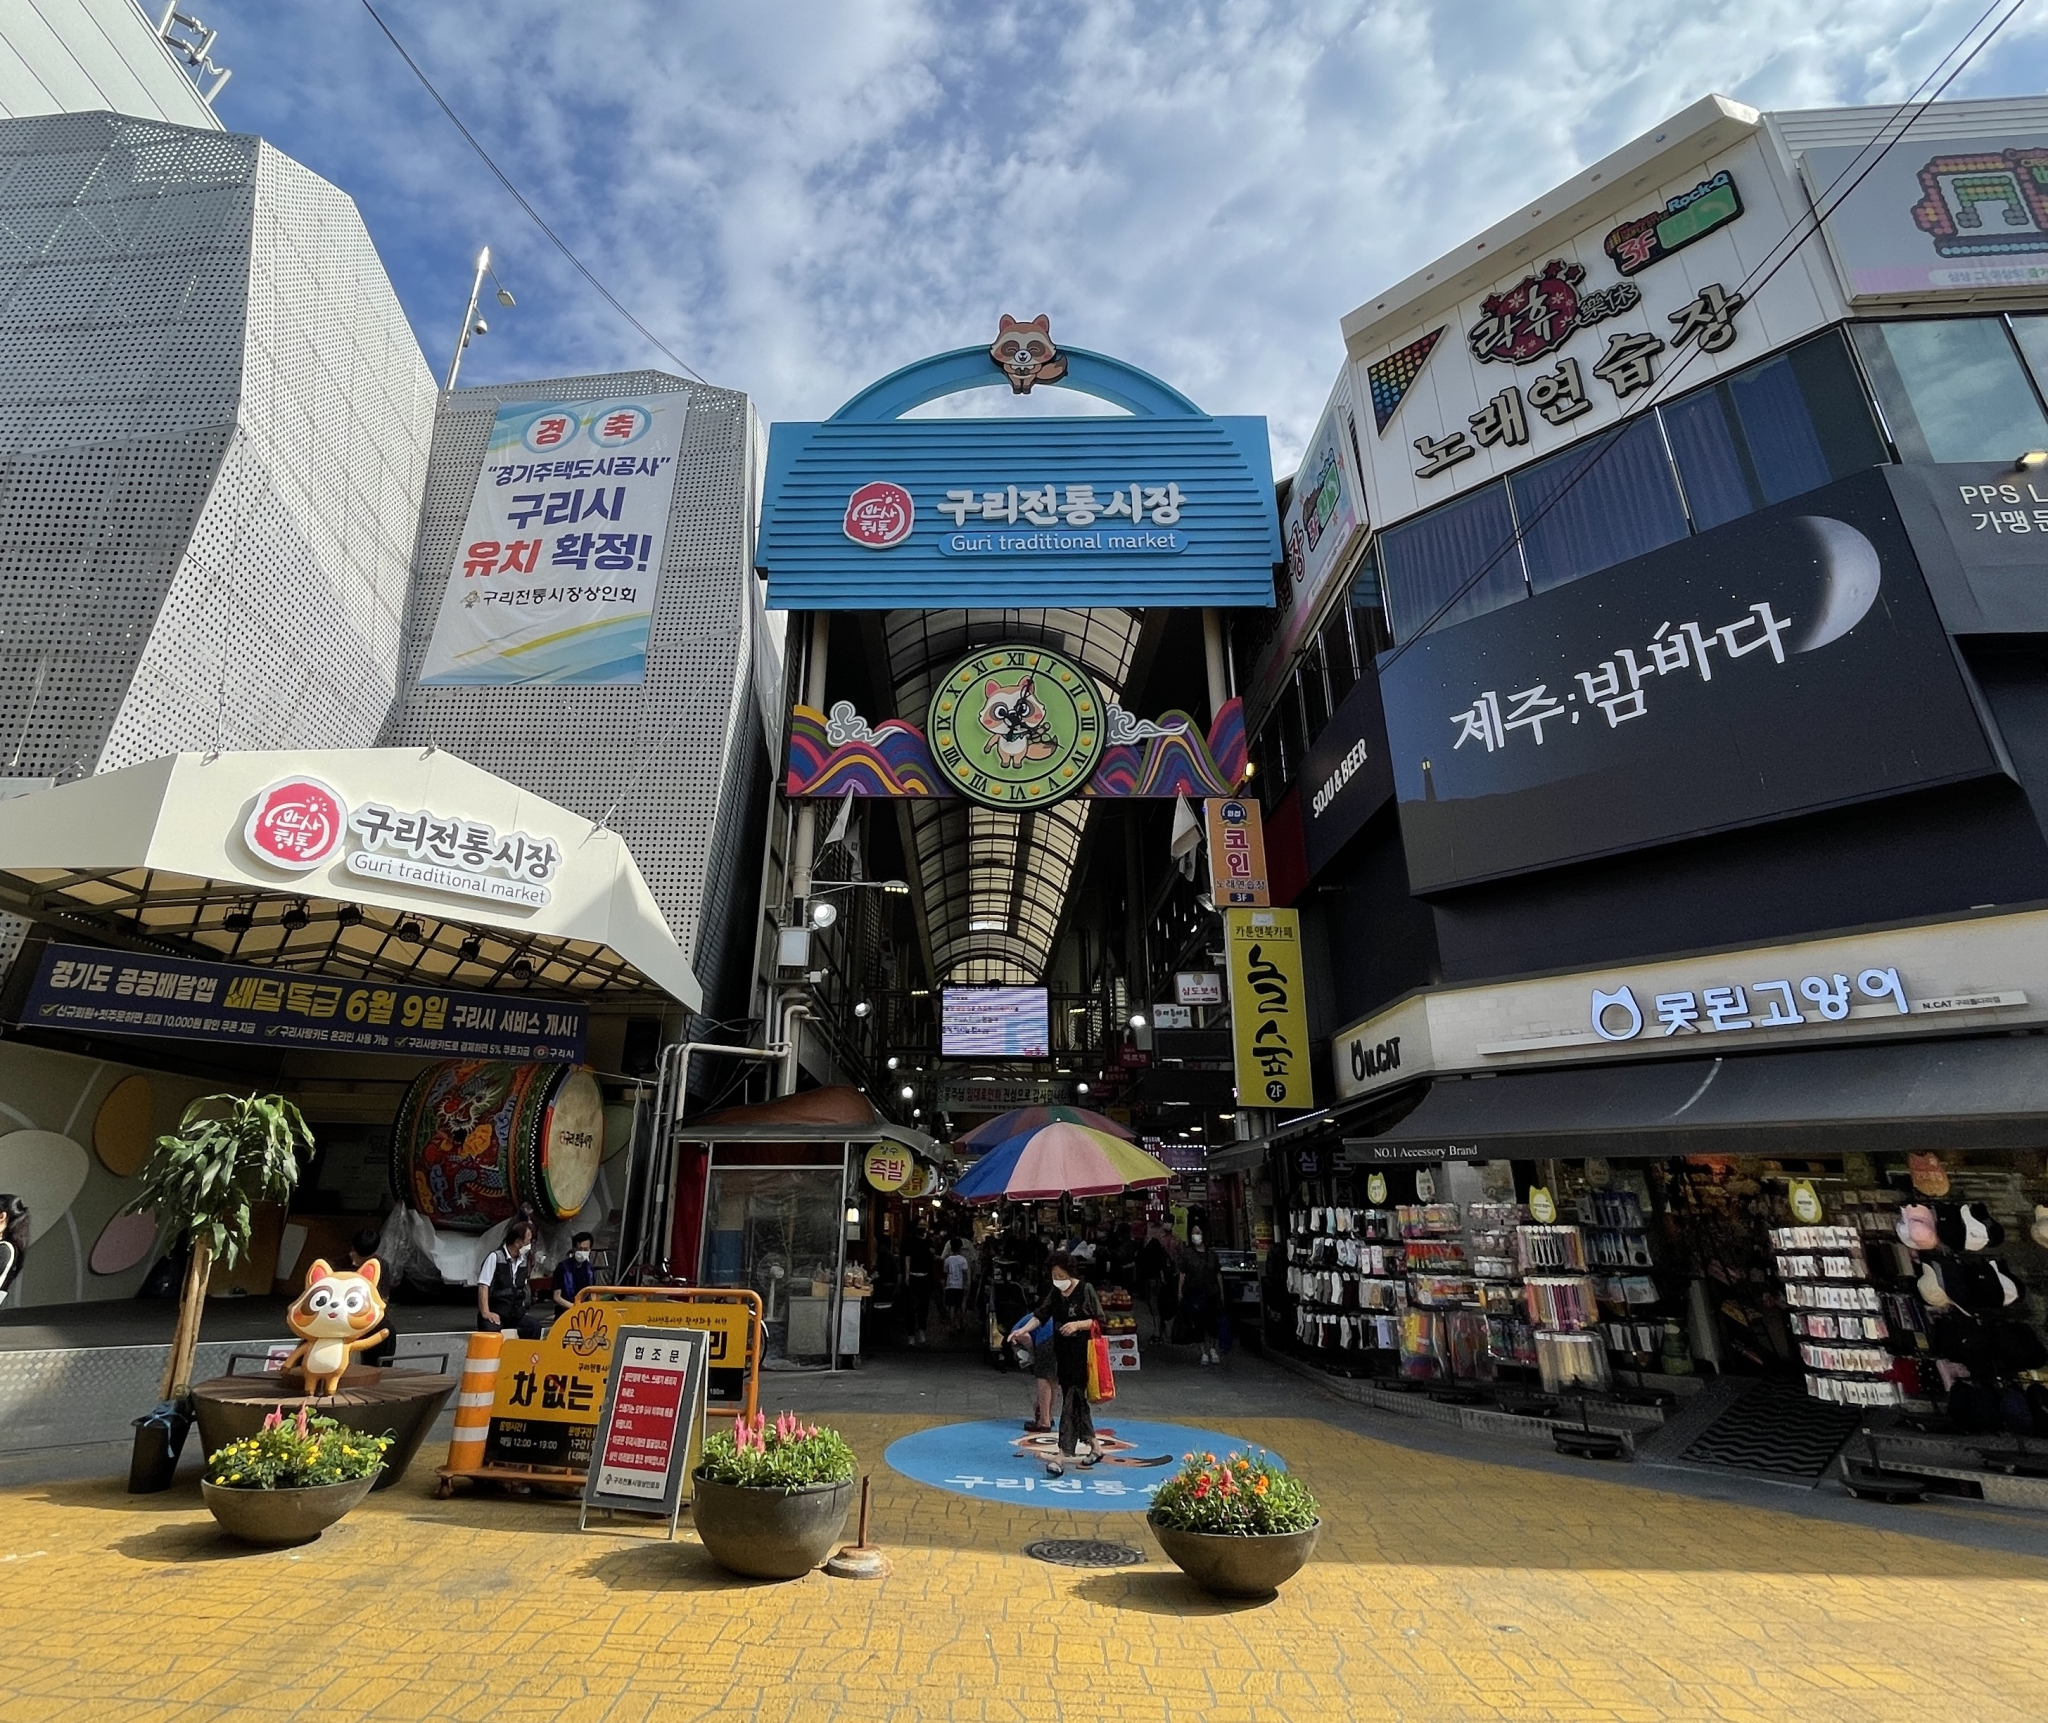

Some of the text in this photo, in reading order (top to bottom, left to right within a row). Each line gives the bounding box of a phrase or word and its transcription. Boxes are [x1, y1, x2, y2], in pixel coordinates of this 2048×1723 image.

[1616, 228, 1657, 272] 3F
[1413, 282, 1744, 480] 노래연습장
[536, 418, 566, 446] 경
[603, 414, 635, 438] 축
[937, 481, 1188, 527] 구리전통시장
[1959, 484, 2021, 504] PPS
[507, 487, 627, 530] 구리시
[951, 531, 1176, 552] Guri traditional market
[462, 532, 653, 578] 유치 확정!
[483, 585, 637, 606] 구리전통시장상인회
[1312, 738, 1368, 819] SOJU & BEER
[356, 808, 557, 878] 구리전통시장
[1224, 828, 1251, 878] 코인
[354, 854, 546, 904] Guri traditional market
[1216, 879, 1265, 890] 노래연습장
[1236, 893, 1247, 902] 3F
[50, 960, 114, 992] 경기도
[115, 967, 219, 1003] 공공배달앱
[344, 989, 398, 1025] 6월
[400, 995, 450, 1030] 9일
[452, 1004, 498, 1031] 구리시
[499, 1009, 541, 1034] 서비스
[544, 1014, 580, 1038] 개시!
[1654, 966, 1910, 1038] 못된고양이
[1922, 999, 1952, 1009] N.CAT
[163, 1014, 203, 1030] 10,000원
[279, 1025, 389, 1046] 구리사랑카드 온라인 사용 가능
[489, 1043, 502, 1055] 5%
[549, 1047, 575, 1059] 구리시
[1269, 1084, 1283, 1098] 2F
[1374, 1144, 1478, 1160] NO.1 Accessory Brand
[870, 1158, 906, 1182] 족발
[578, 1363, 608, 1374] 구리전통시
[509, 1371, 538, 1407] 차
[542, 1373, 594, 1412] 없는
[513, 1438, 532, 1448] 12:00
[539, 1440, 558, 1450] 19:00
